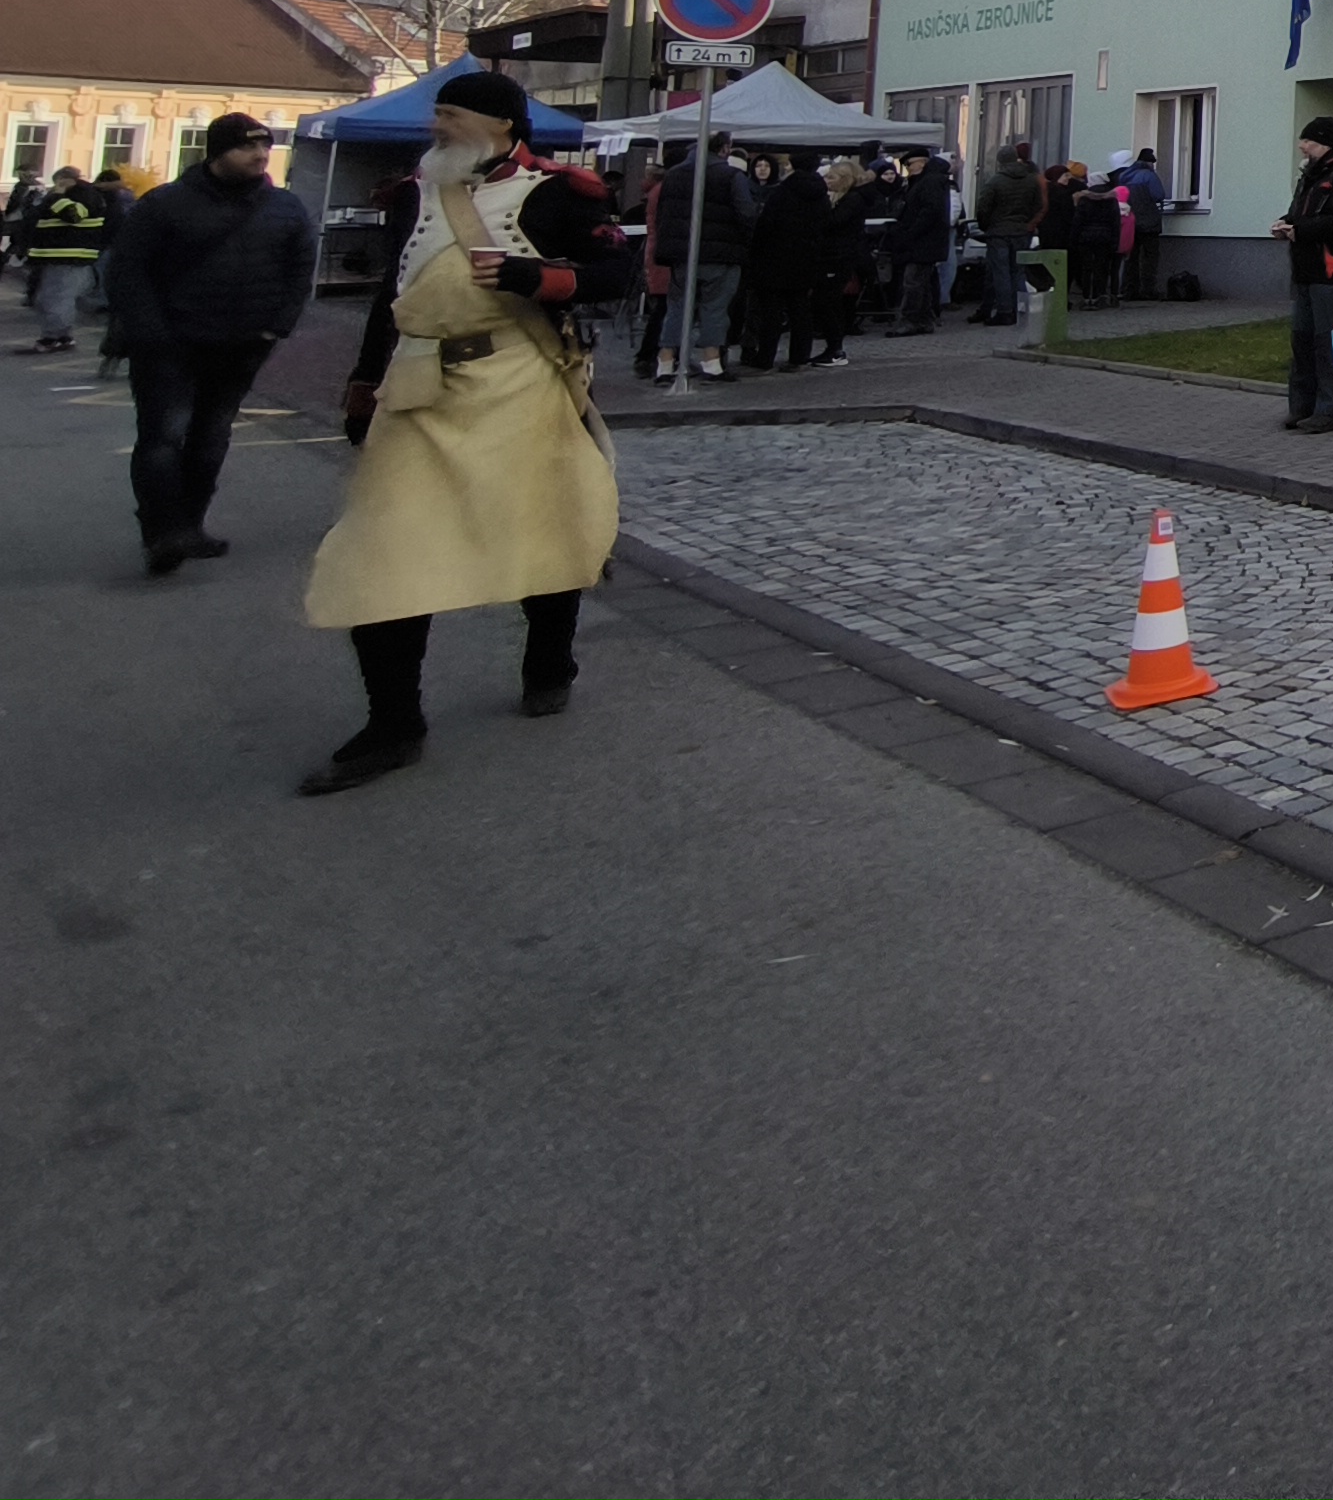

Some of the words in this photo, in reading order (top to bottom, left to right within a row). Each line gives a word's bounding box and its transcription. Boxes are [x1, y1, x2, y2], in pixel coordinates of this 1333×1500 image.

[906, 5, 970, 41] HASIČSKÁ
[691, 48, 711, 61] 24
[716, 52, 731, 62] m
